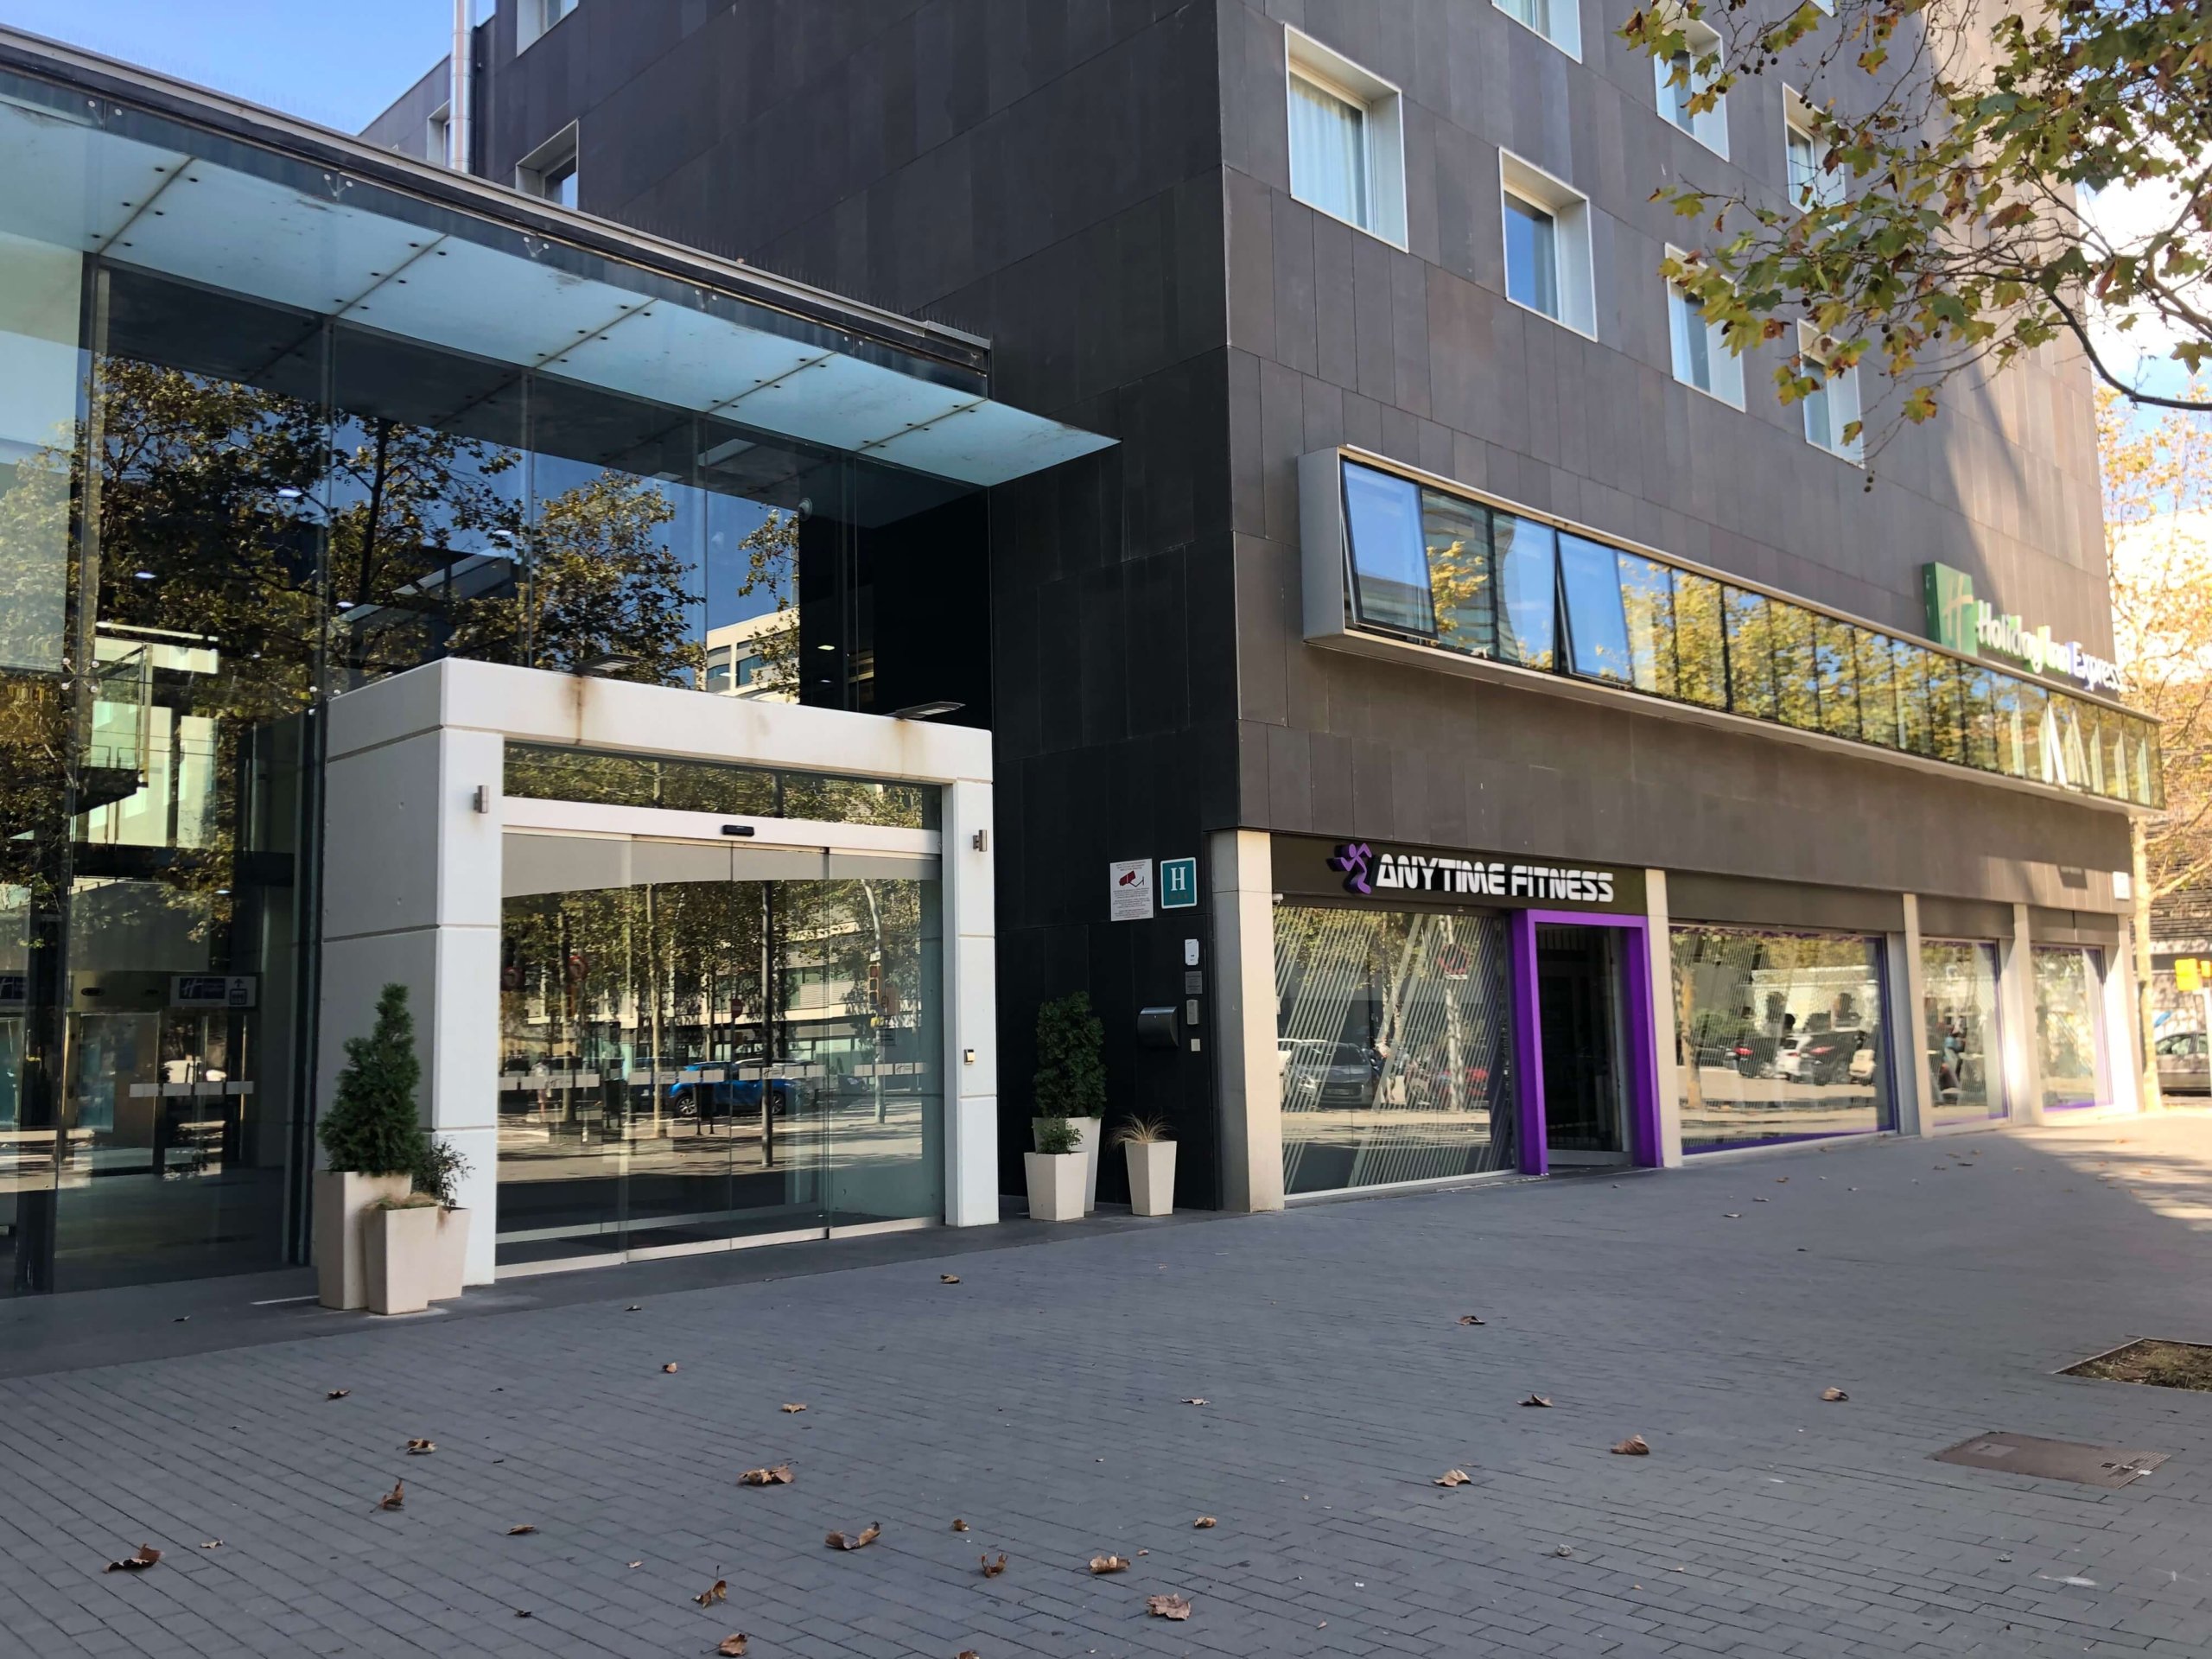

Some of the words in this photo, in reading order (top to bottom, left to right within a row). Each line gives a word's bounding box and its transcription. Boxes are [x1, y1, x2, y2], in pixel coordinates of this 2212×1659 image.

[1976, 599, 2044, 674] Holiday
[2041, 626, 2072, 675] Inn
[1171, 867, 1186, 891] H
[1376, 853, 1505, 895] ANYTIME
[1511, 865, 1614, 903] FITNESS
